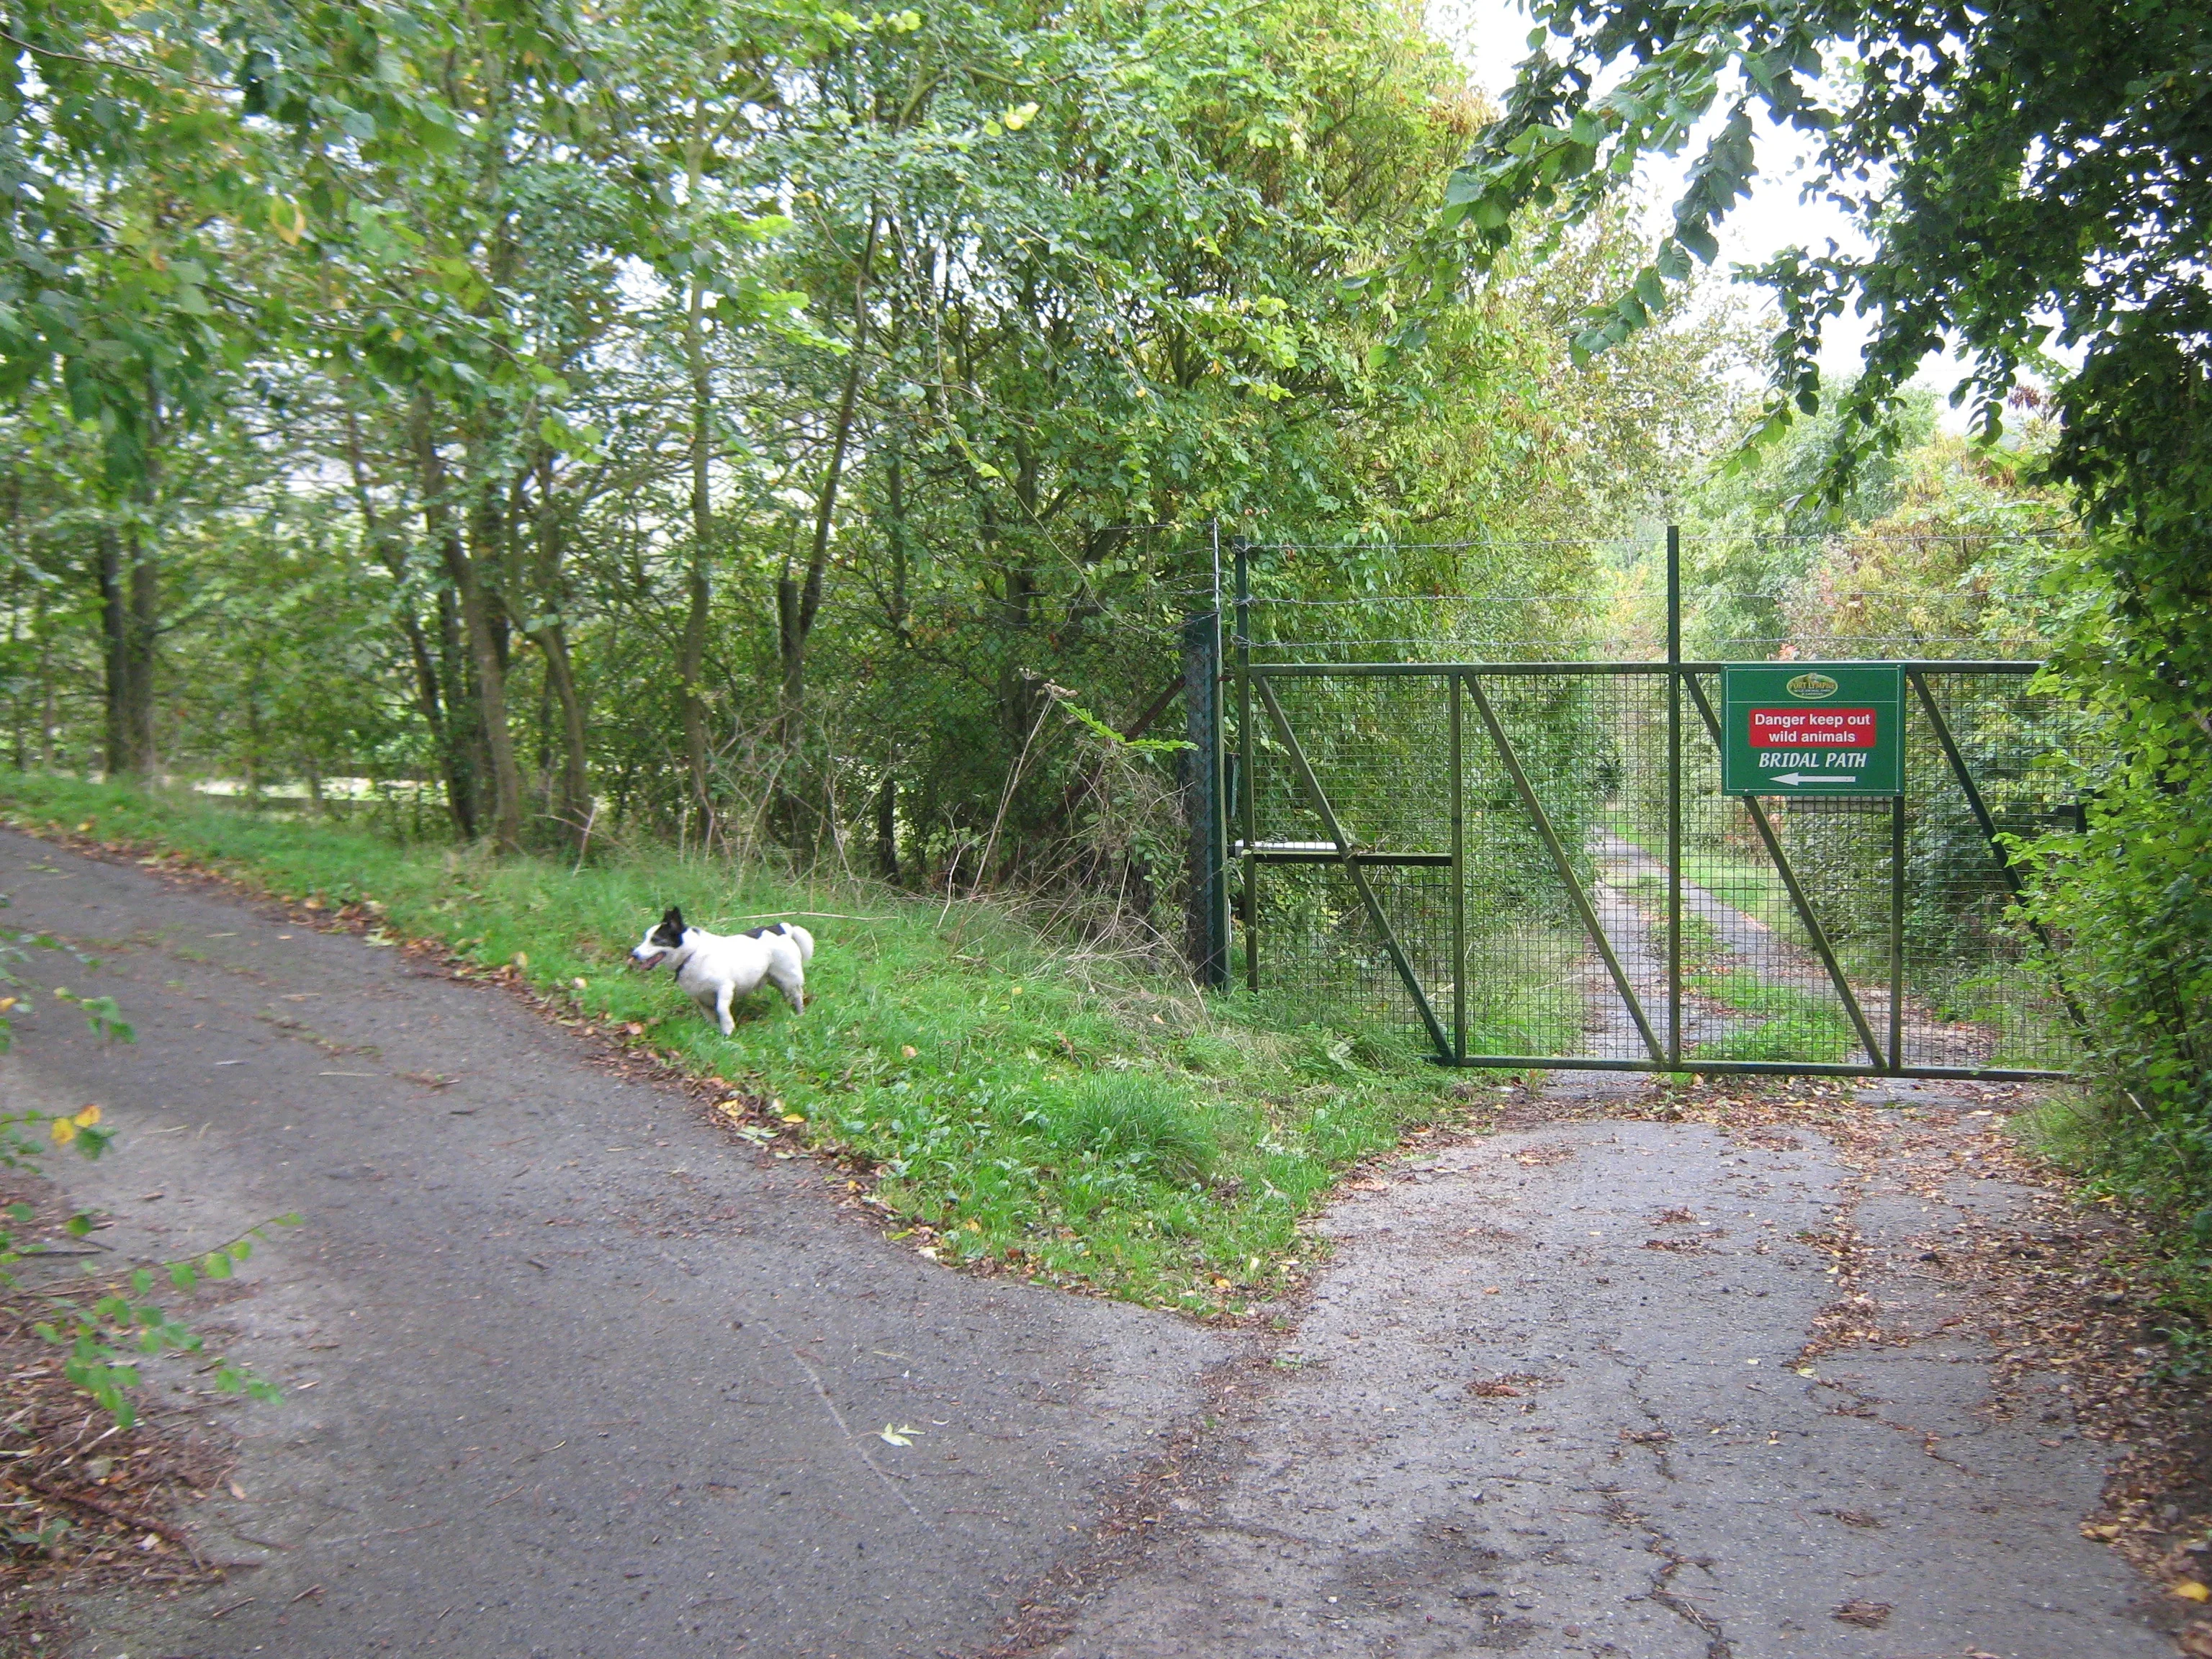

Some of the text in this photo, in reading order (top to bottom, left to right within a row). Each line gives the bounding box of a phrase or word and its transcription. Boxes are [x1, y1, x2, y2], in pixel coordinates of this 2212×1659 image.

[1755, 714, 1871, 728] Danger keep out
[1768, 731, 1856, 742] wild animals
[1759, 752, 1867, 768] BRIDAL PATH
